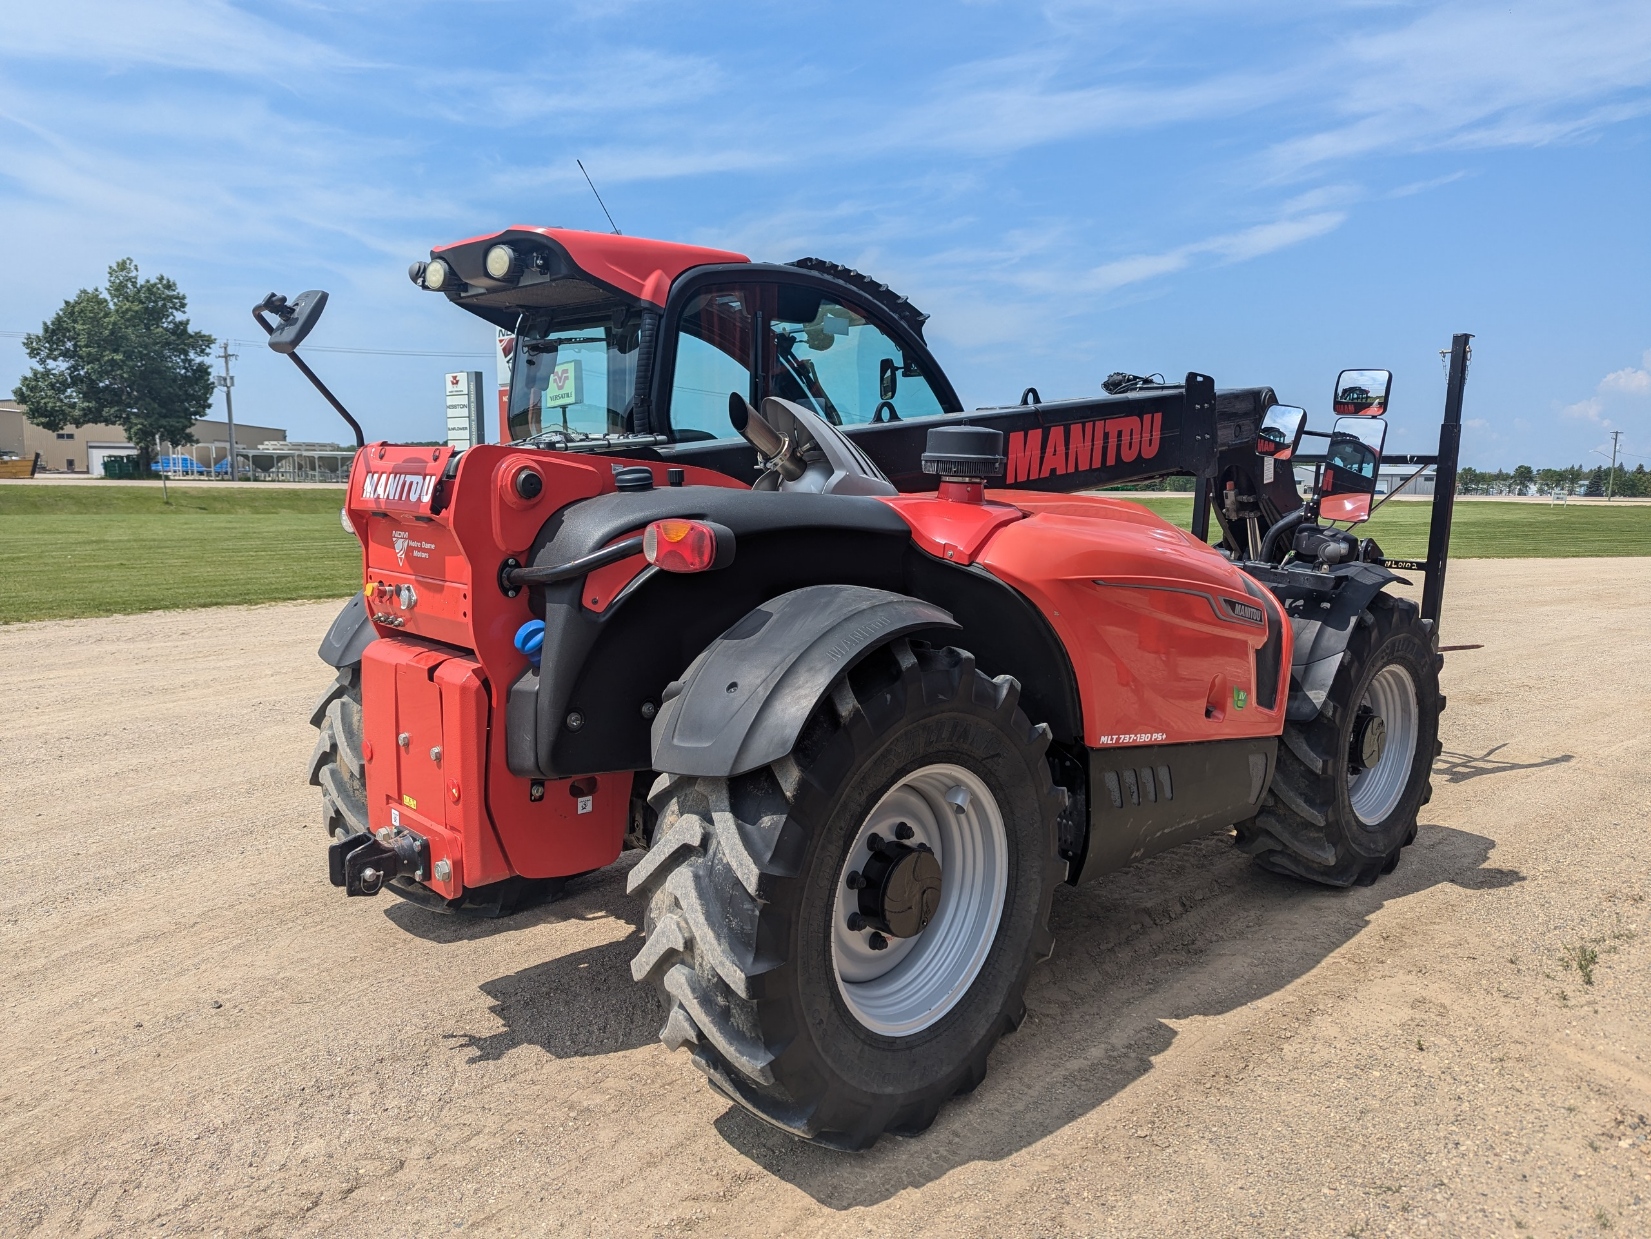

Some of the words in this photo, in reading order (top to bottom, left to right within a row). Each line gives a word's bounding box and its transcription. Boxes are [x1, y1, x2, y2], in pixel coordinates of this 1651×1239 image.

[549, 391, 573, 401] VERSATILE
[1006, 412, 1162, 485] MANITOU
[362, 472, 436, 503] MANITOU
[409, 539, 421, 548] Notre
[421, 541, 436, 550] Dame
[412, 549, 429, 559] Motors
[1234, 602, 1261, 622] MANITOU
[1099, 735, 1119, 745] MLT
[1151, 732, 1167, 742] PS+
